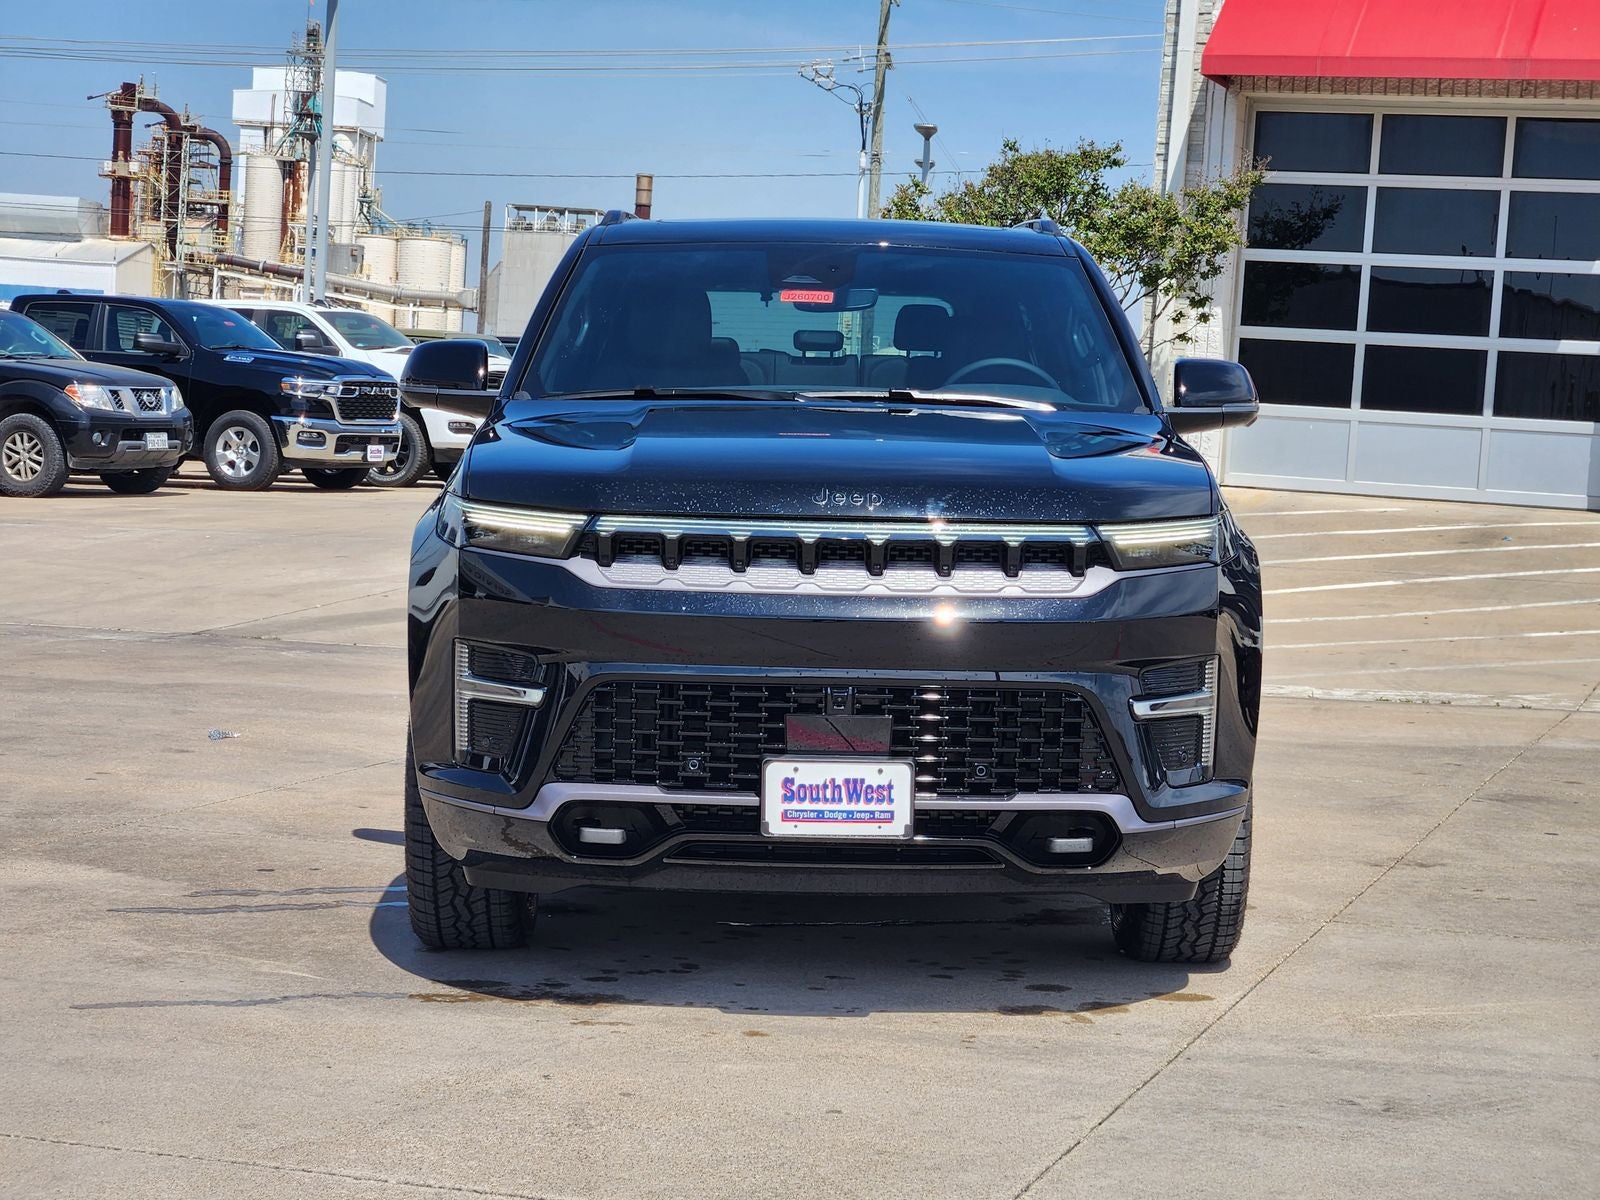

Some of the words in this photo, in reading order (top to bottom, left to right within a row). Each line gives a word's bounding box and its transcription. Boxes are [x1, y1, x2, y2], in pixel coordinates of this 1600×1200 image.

[360, 385, 391, 396] RAM
[811, 487, 883, 511] Jeep
[781, 777, 895, 805] SouthWest
[787, 810, 818, 820] Chrysler
[824, 810, 848, 820] Dodge
[852, 810, 870, 821] Jeep
[874, 810, 891, 819] Ram
